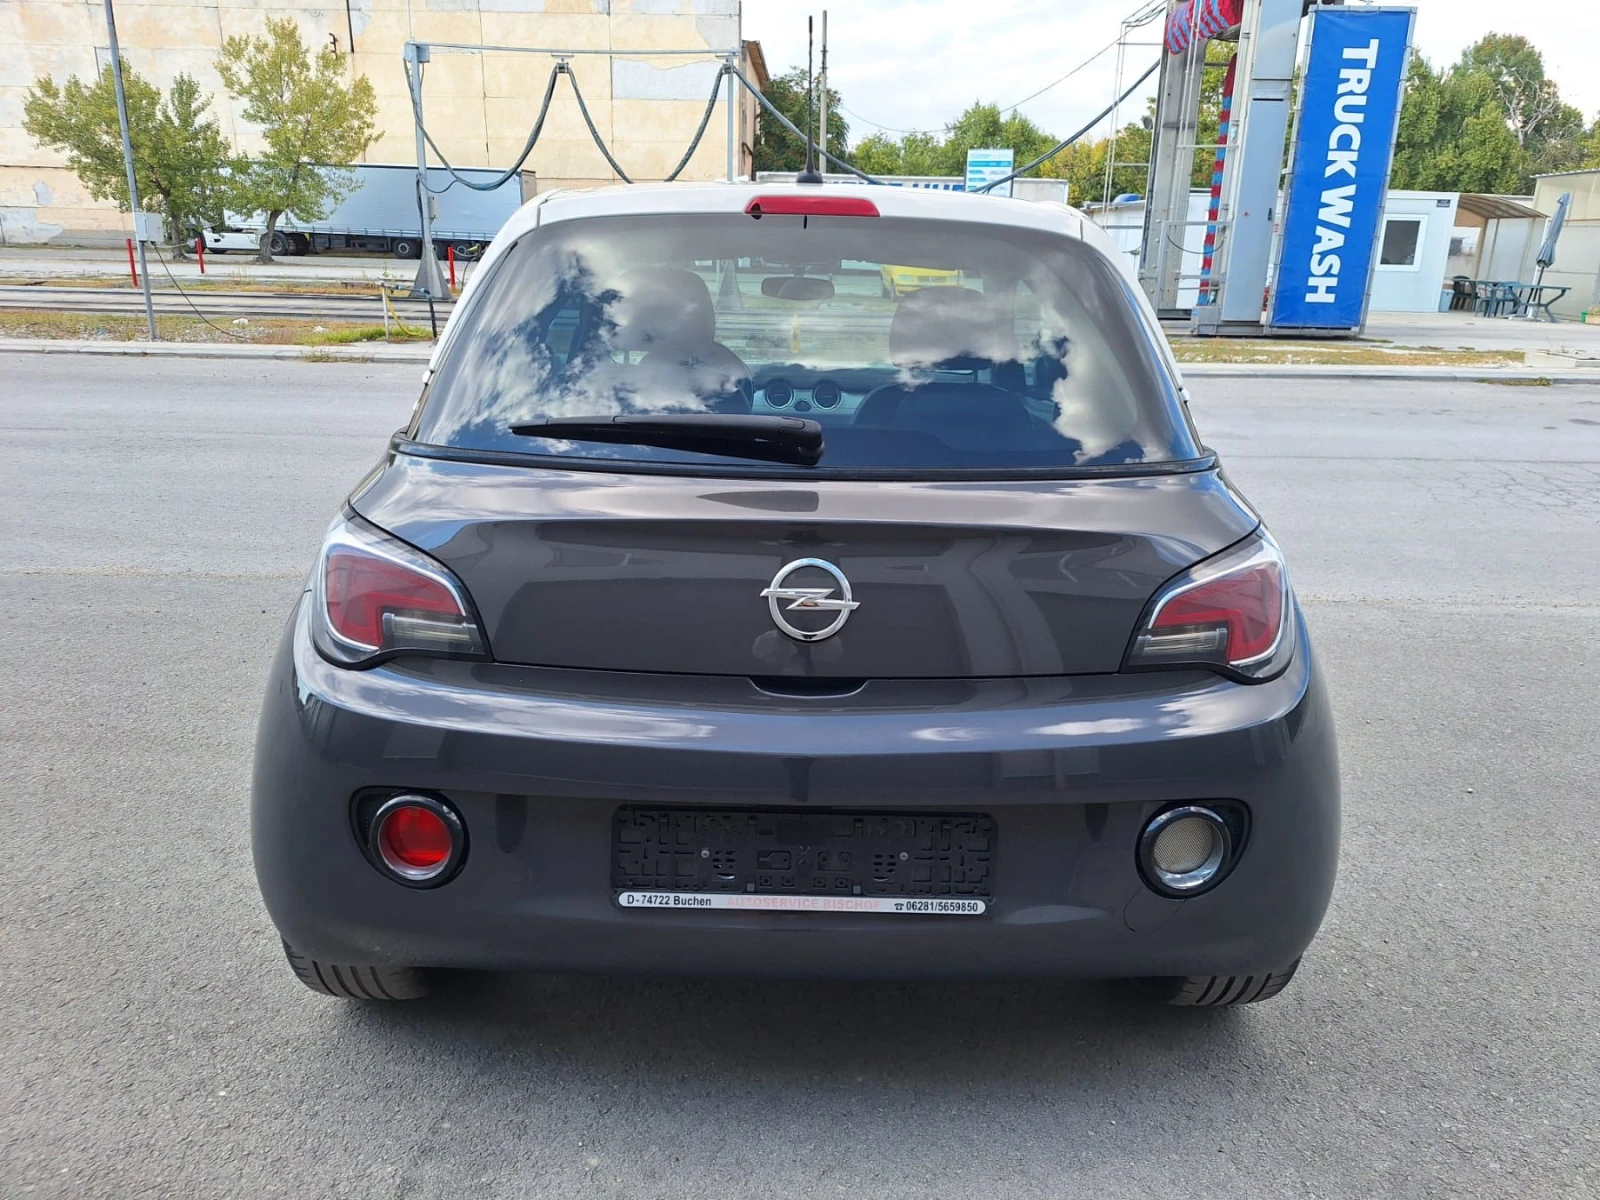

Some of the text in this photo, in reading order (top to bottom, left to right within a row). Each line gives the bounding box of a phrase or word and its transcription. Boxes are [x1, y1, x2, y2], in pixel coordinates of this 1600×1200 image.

[1304, 38, 1380, 304] TRUCK WASH
[673, 895, 712, 907] Buchen
[727, 896, 819, 909] AUTOSERVICE
[823, 899, 881, 910] BISCHOF
[906, 900, 979, 912] 06281/5659850
